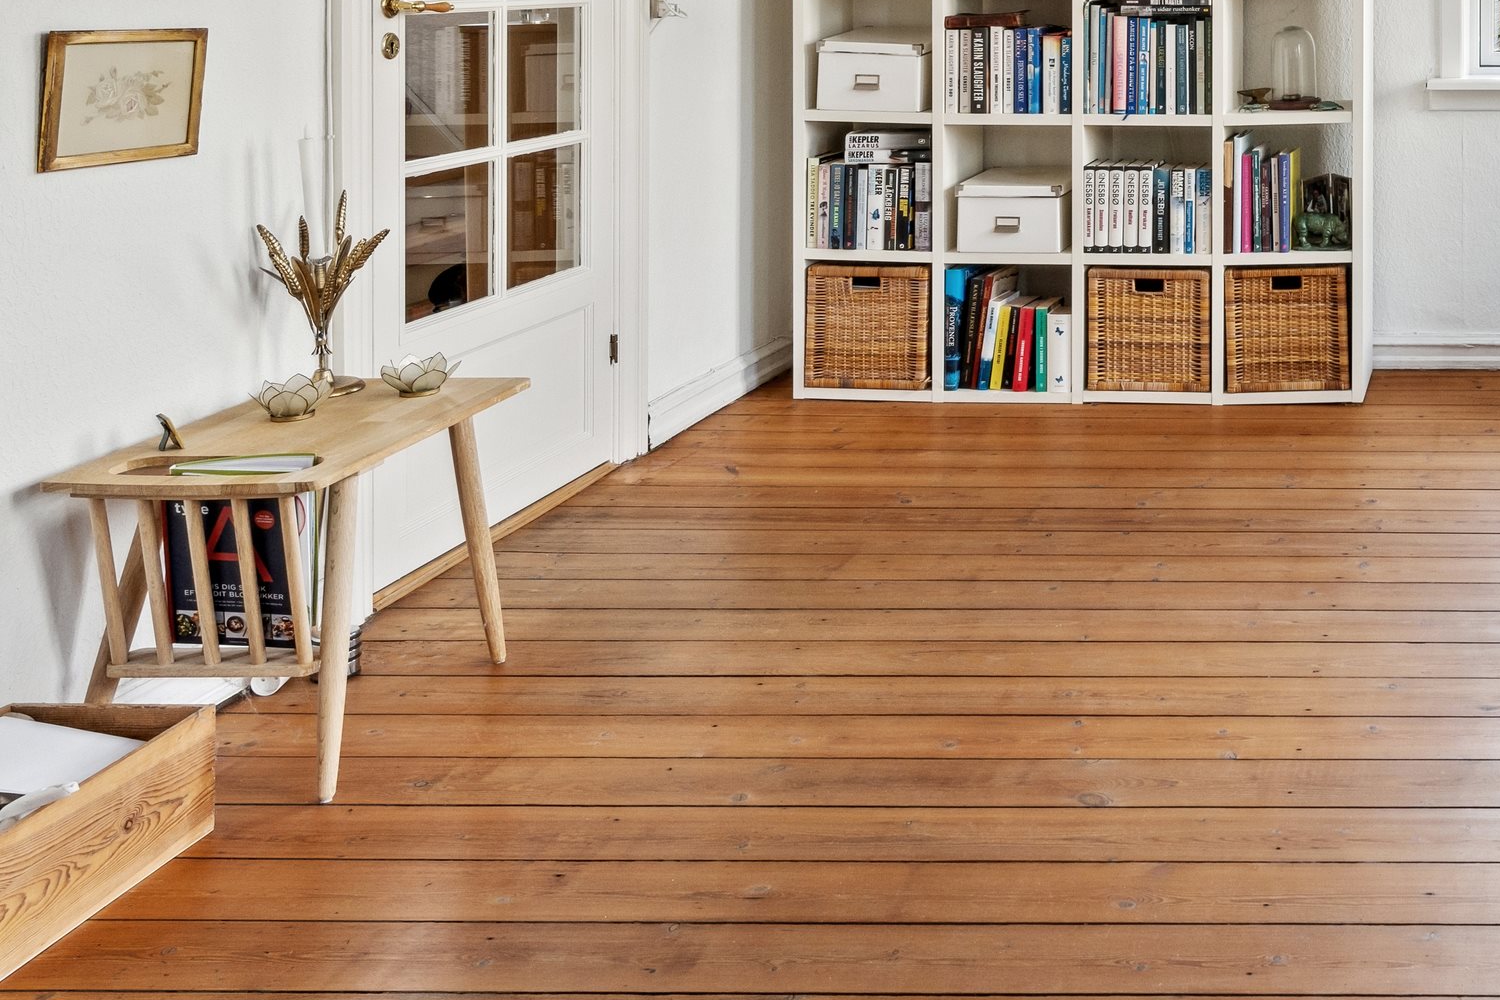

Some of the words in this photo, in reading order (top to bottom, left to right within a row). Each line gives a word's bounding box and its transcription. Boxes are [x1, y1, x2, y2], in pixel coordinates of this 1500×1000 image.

[974, 38, 983, 59] KARIN
[974, 62, 983, 101] SLAUGHTER
[900, 169, 909, 183] ANNA
[1157, 179, 1164, 189] JO
[900, 184, 909, 198] GRUE
[885, 185, 894, 220] LÄCKBERG
[949, 307, 957, 346] PROVENCE
